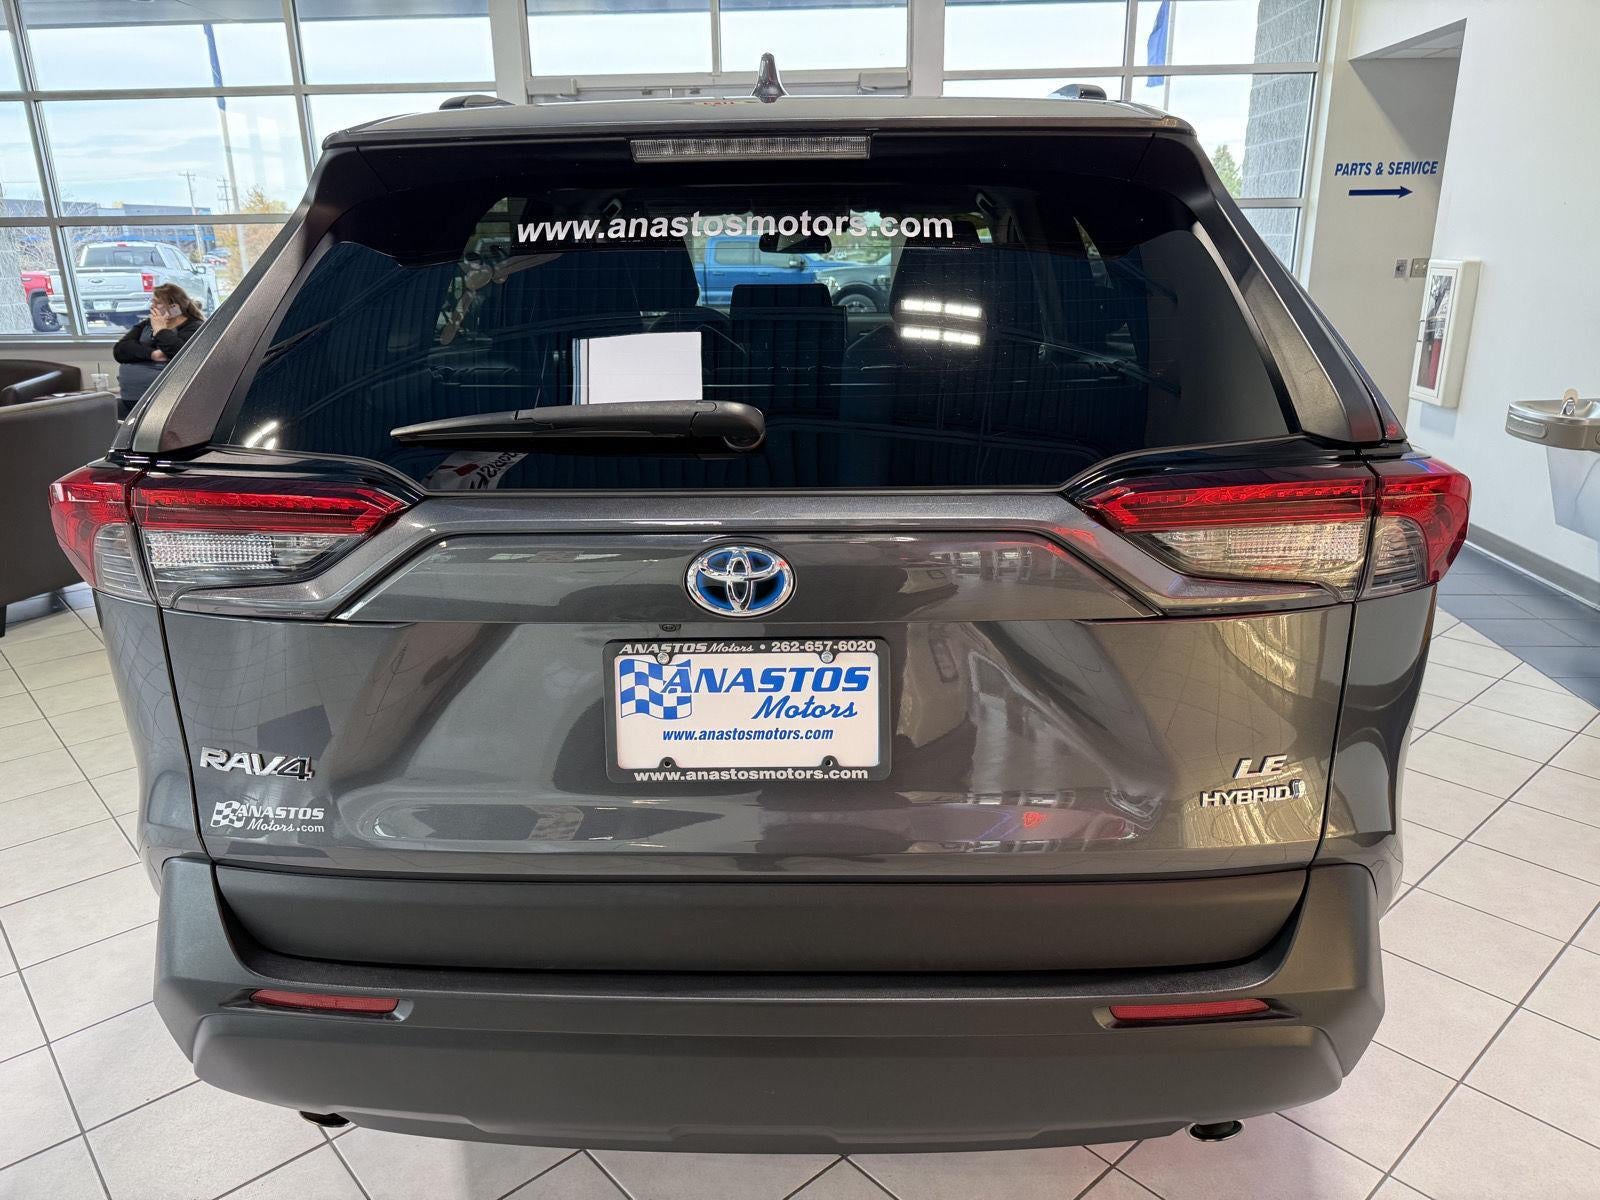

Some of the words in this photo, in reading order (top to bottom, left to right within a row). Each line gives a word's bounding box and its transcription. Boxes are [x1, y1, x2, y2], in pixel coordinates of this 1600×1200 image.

[1334, 162, 1372, 176] PARTS
[1375, 162, 1384, 175] &
[1387, 161, 1438, 175] SERVICE
[517, 209, 954, 243] www.anastosmotors.com
[619, 642, 708, 654] ANASTOS
[707, 642, 754, 654] Motors
[771, 640, 876, 652] 262-657-6020
[660, 664, 871, 693] ANASTOS
[751, 695, 858, 720] Motors
[662, 727, 834, 741] www.anastosmotors.com
[200, 746, 315, 781] RAV4
[634, 768, 868, 782] www.anastosmotors.com
[1232, 753, 1288, 779] LE
[1200, 784, 1292, 808] HYBRID
[235, 803, 325, 820] ANASTOS
